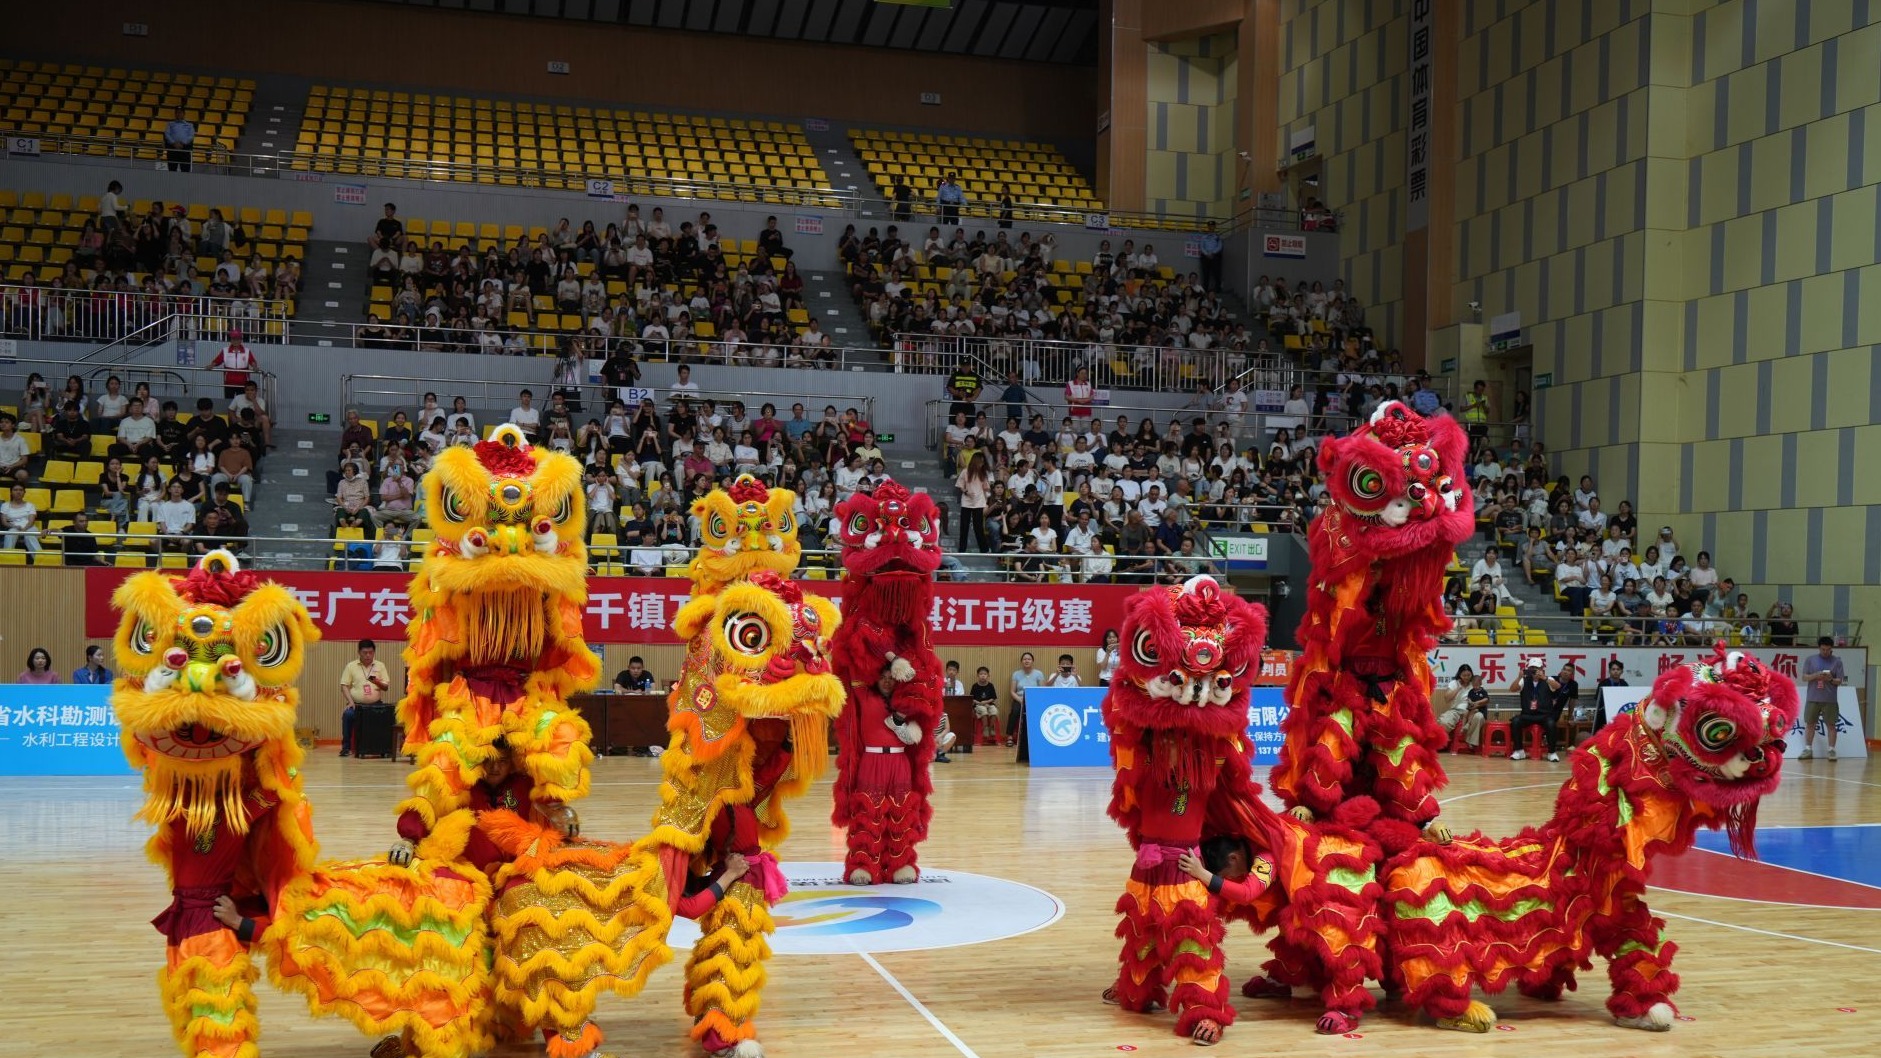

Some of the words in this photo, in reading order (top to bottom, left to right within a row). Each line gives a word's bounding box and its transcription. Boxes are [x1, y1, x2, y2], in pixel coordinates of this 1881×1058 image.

[1410, 0, 1429, 203] 中国体育彩票
[16, 138, 34, 149] C1
[593, 181, 609, 191] C2
[1091, 215, 1105, 224] C3
[629, 388, 648, 400] B2
[1229, 543, 1246, 554] EXIT
[1247, 543, 1263, 555] 出口
[22, 732, 120, 748] 水利工程设计
[1258, 746, 1271, 755] 137
